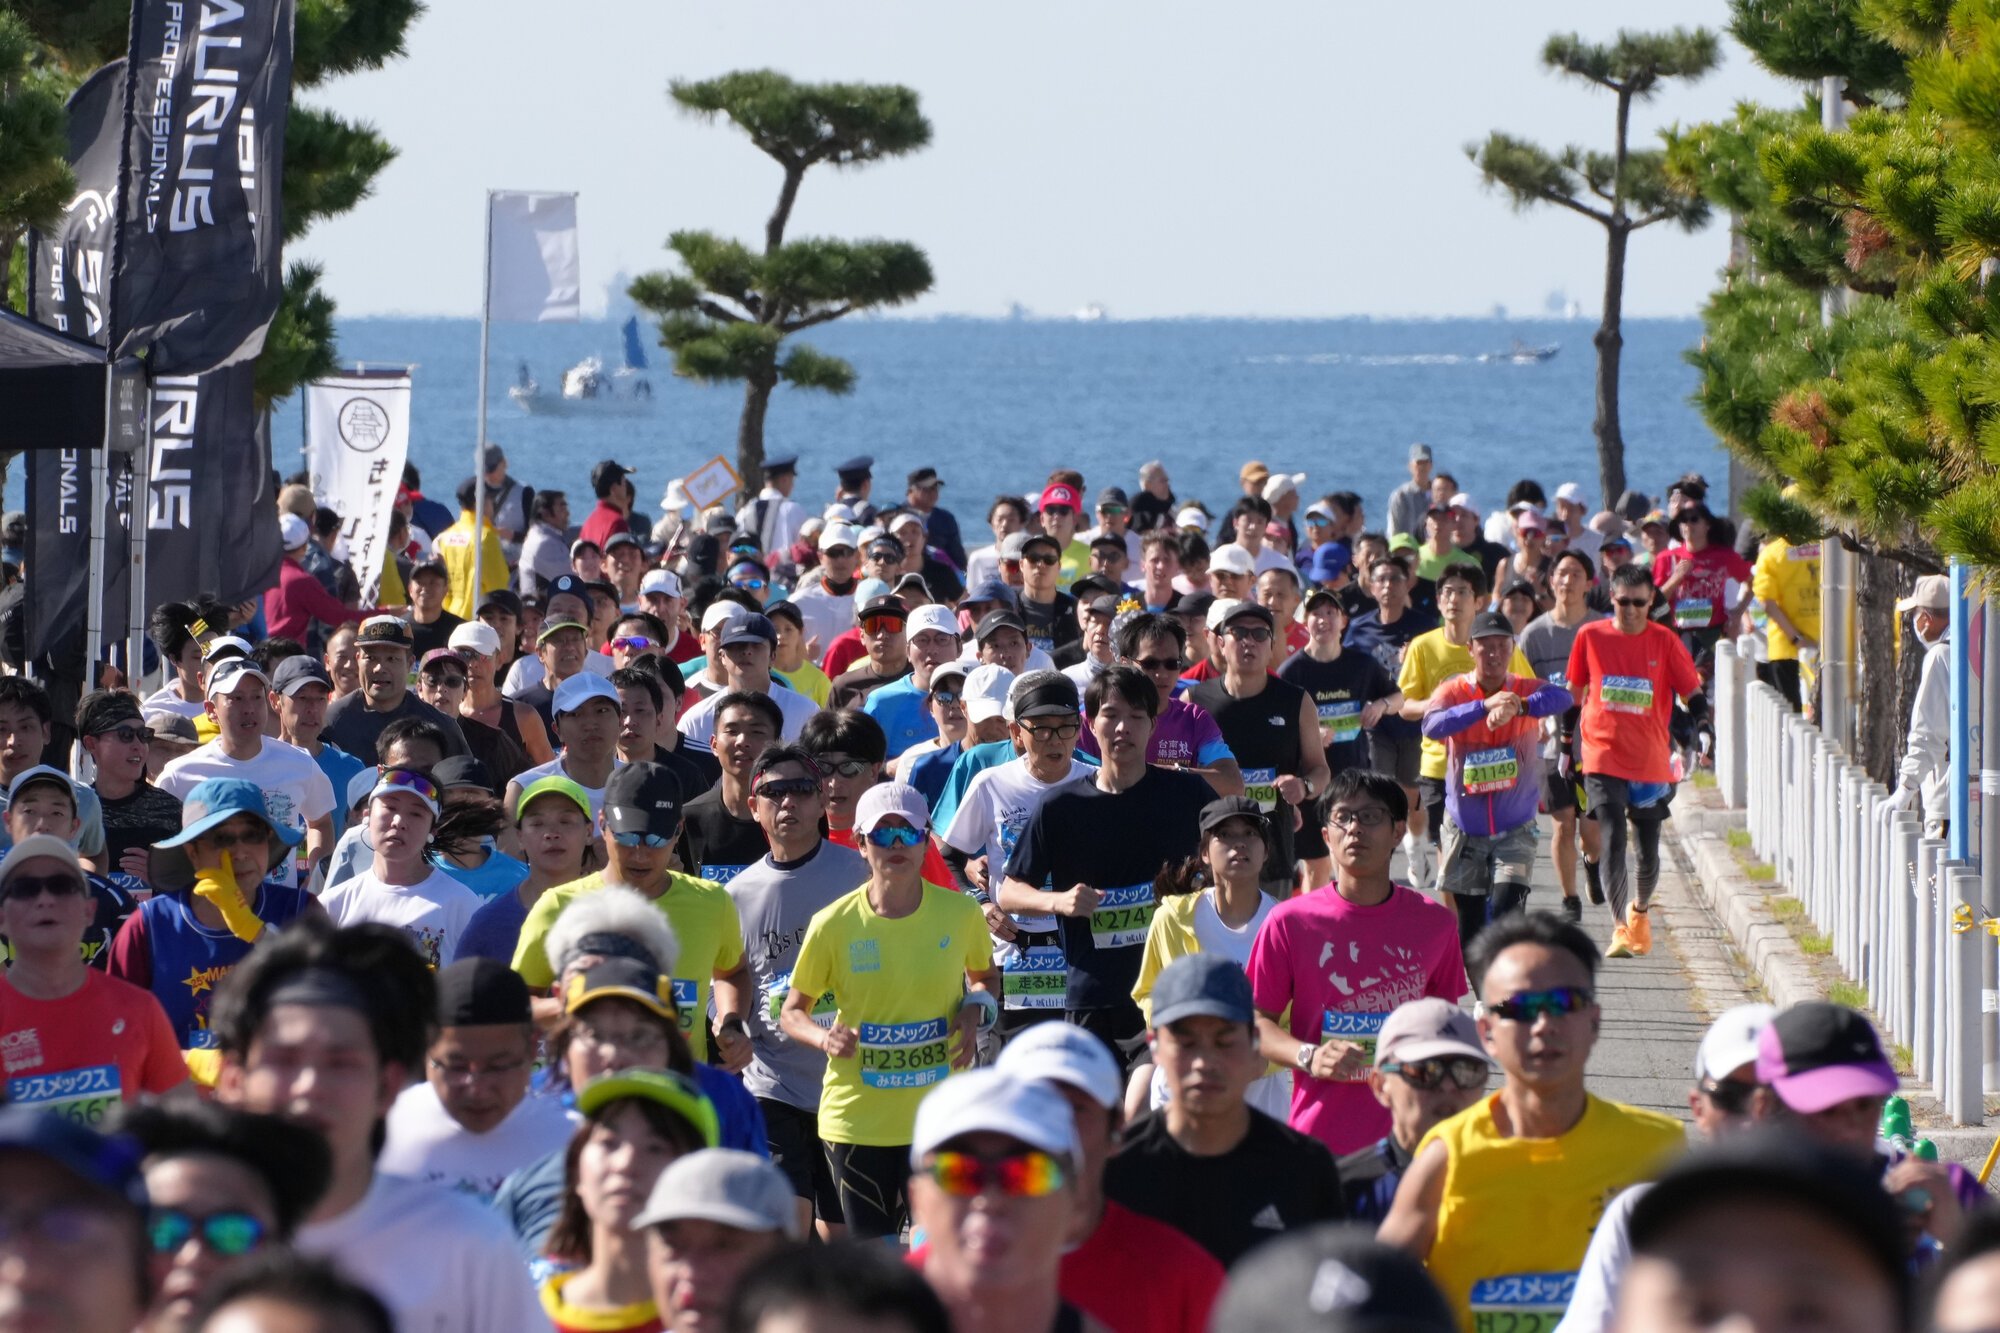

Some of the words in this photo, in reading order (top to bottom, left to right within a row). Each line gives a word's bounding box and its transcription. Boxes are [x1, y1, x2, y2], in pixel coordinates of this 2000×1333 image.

[51, 247, 65, 302] FOR
[868, 1021, 939, 1042] シスメックス
[863, 1043, 947, 1070] H23683
[14, 1068, 110, 1100] シスメックス
[876, 1070, 937, 1087] みなと銀行
